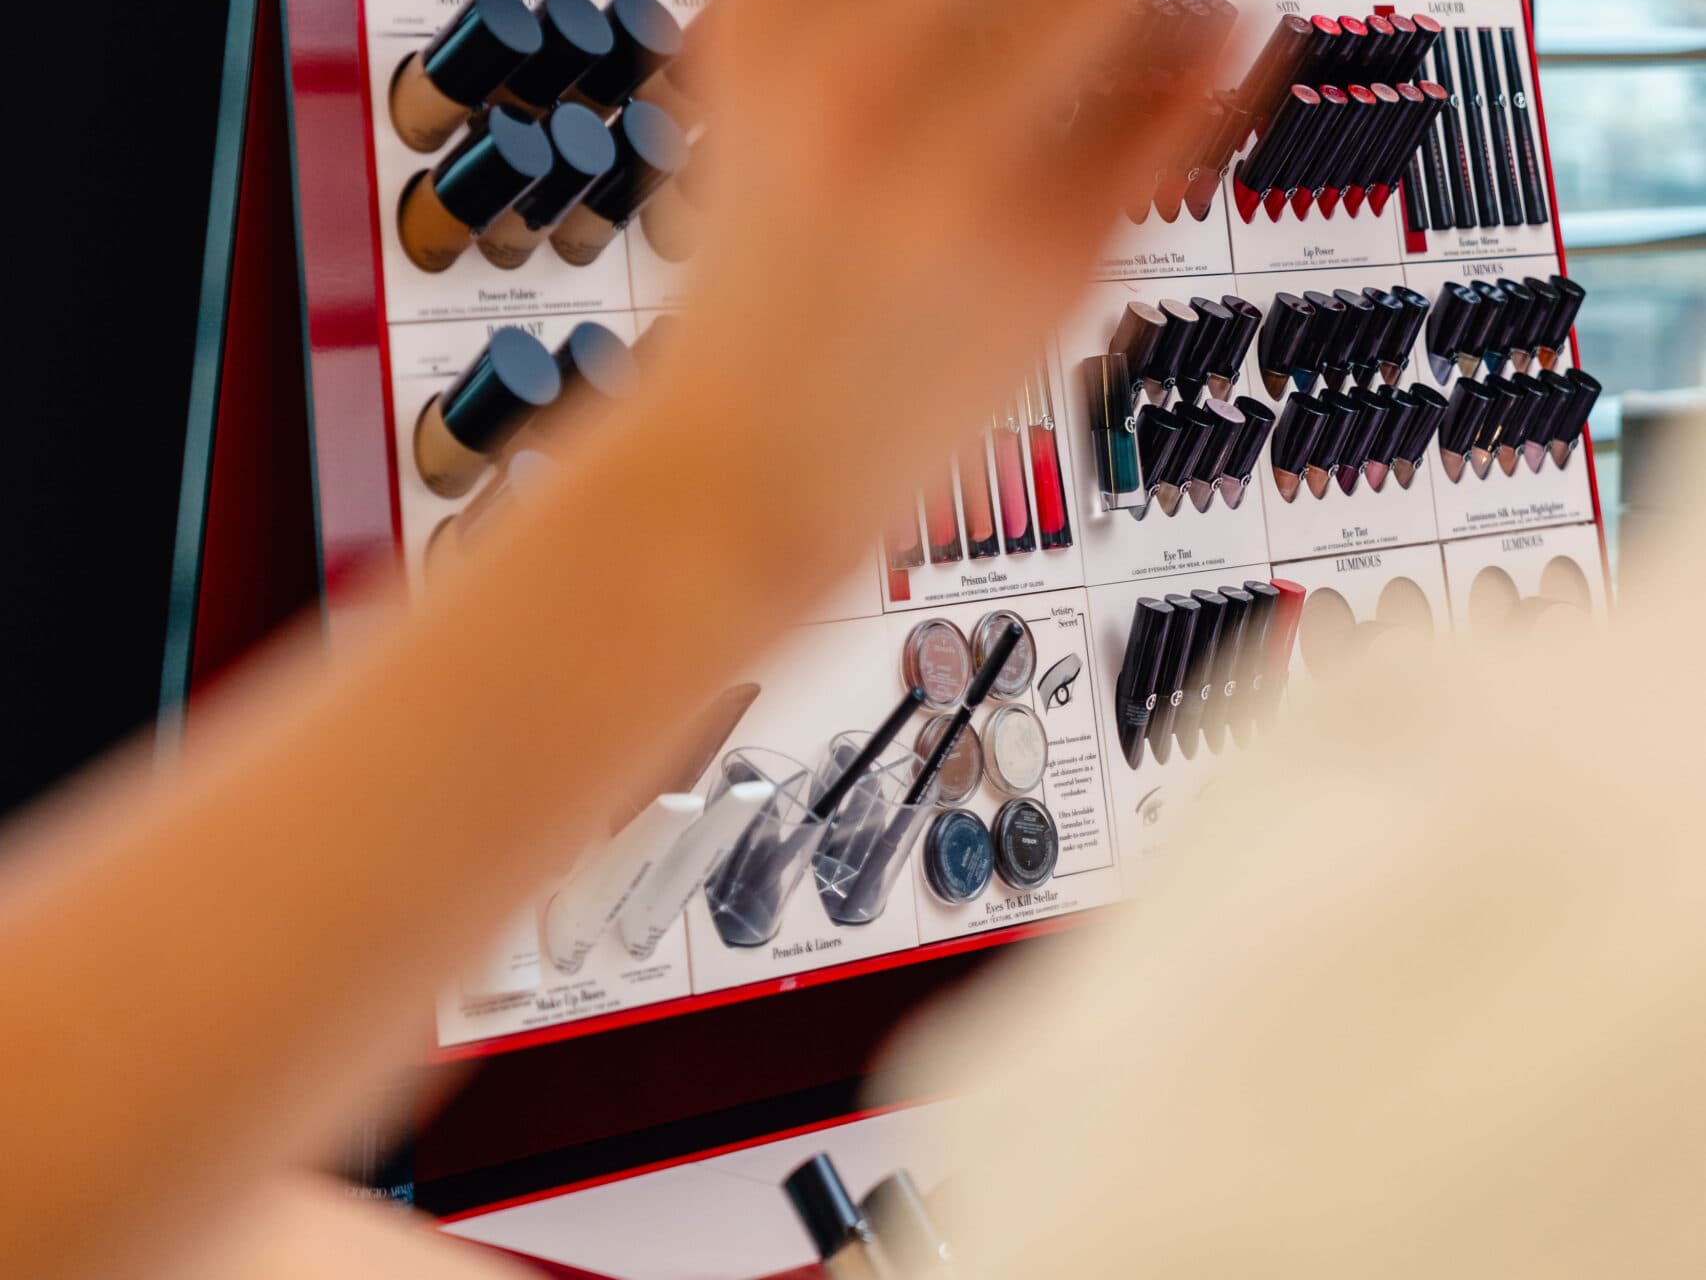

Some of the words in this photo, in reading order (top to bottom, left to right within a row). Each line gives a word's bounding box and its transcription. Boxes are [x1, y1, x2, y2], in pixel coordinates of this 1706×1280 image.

[1276, 0, 1300, 13] SATIN
[1428, 1, 1465, 17] LACQUER
[1134, 255, 1148, 265] Silk
[1149, 253, 1170, 265] Cheek
[1171, 252, 1185, 263] Tint
[1303, 247, 1314, 260] Lip
[1315, 246, 1335, 257] Power
[1462, 263, 1504, 277] LUMINOUS
[478, 289, 506, 302] Power
[509, 288, 536, 301] Fabric
[1466, 512, 1497, 522] Luminous
[1498, 507, 1509, 518] Silk
[1530, 501, 1564, 514] Highlighter
[1341, 528, 1354, 542] Eye
[1354, 526, 1368, 537] Tint
[1502, 533, 1544, 552] LUMINOUS
[1163, 550, 1177, 565] Eye
[1177, 548, 1192, 559] Tint
[1336, 553, 1382, 573] LUMINOUS
[960, 575, 987, 587] Prisma
[988, 571, 1008, 582] Glass
[1050, 607, 1075, 618] Artistry
[1058, 618, 1078, 628] Secret
[985, 902, 1004, 917] Eyes
[1005, 897, 1016, 910] To
[1017, 893, 1032, 908] Kill
[1033, 890, 1058, 904] Stellar
[968, 919, 988, 928] CREAMY
[772, 943, 803, 960] Pencils
[805, 940, 813, 953] &
[815, 937, 842, 951] Liners
